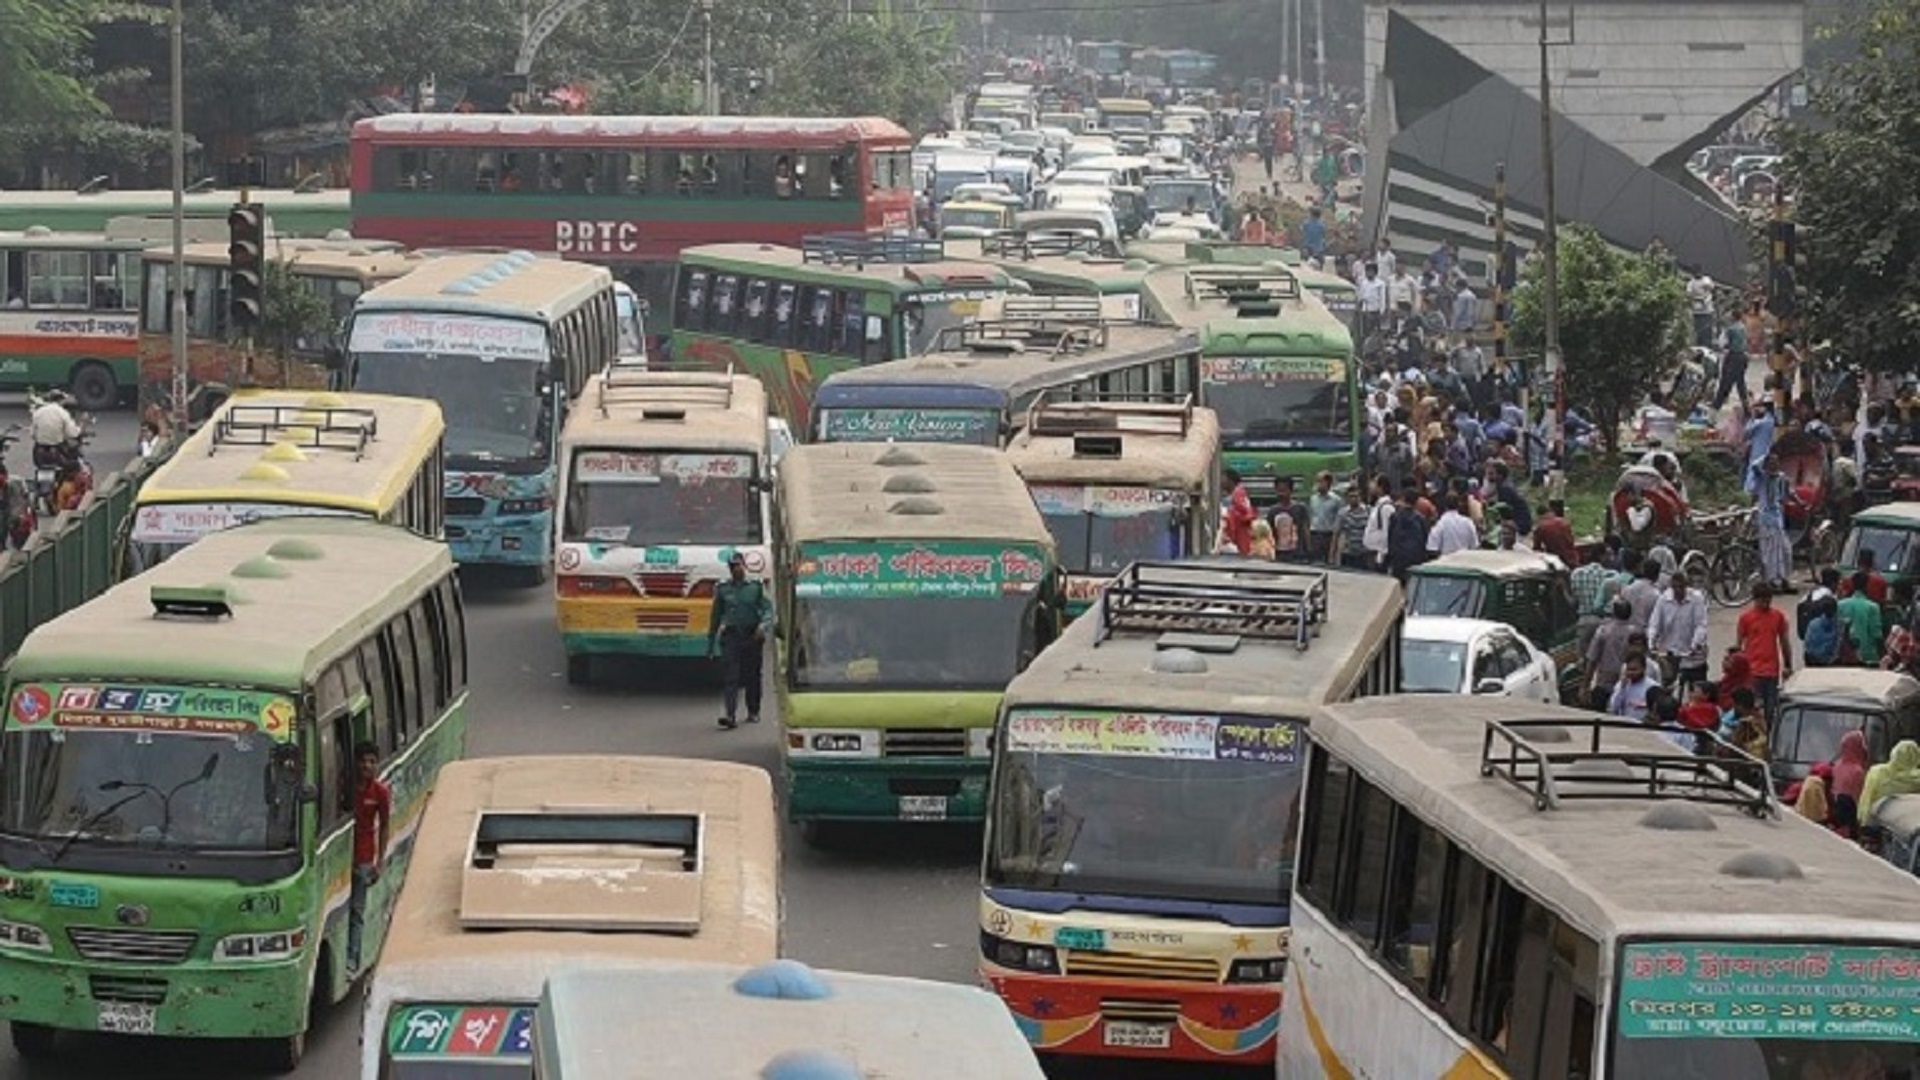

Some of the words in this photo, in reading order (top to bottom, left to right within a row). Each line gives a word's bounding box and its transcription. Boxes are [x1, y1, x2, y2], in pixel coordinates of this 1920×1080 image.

[556, 220, 638, 252] BRTC
[846, 411, 890, 431] New
[906, 411, 966, 434] Vision
[819, 552, 882, 579] ঢাকা
[888, 549, 994, 580] পরিবহন
[999, 549, 1043, 580] লিঃ
[184, 692, 235, 716] পরিবহন
[1841, 952, 1920, 982] সার্ভি
[1628, 998, 1715, 1018] মিরপুর
[1731, 1001, 1814, 1017] ১৩-১৪
[1826, 999, 1898, 1019] হইতে
